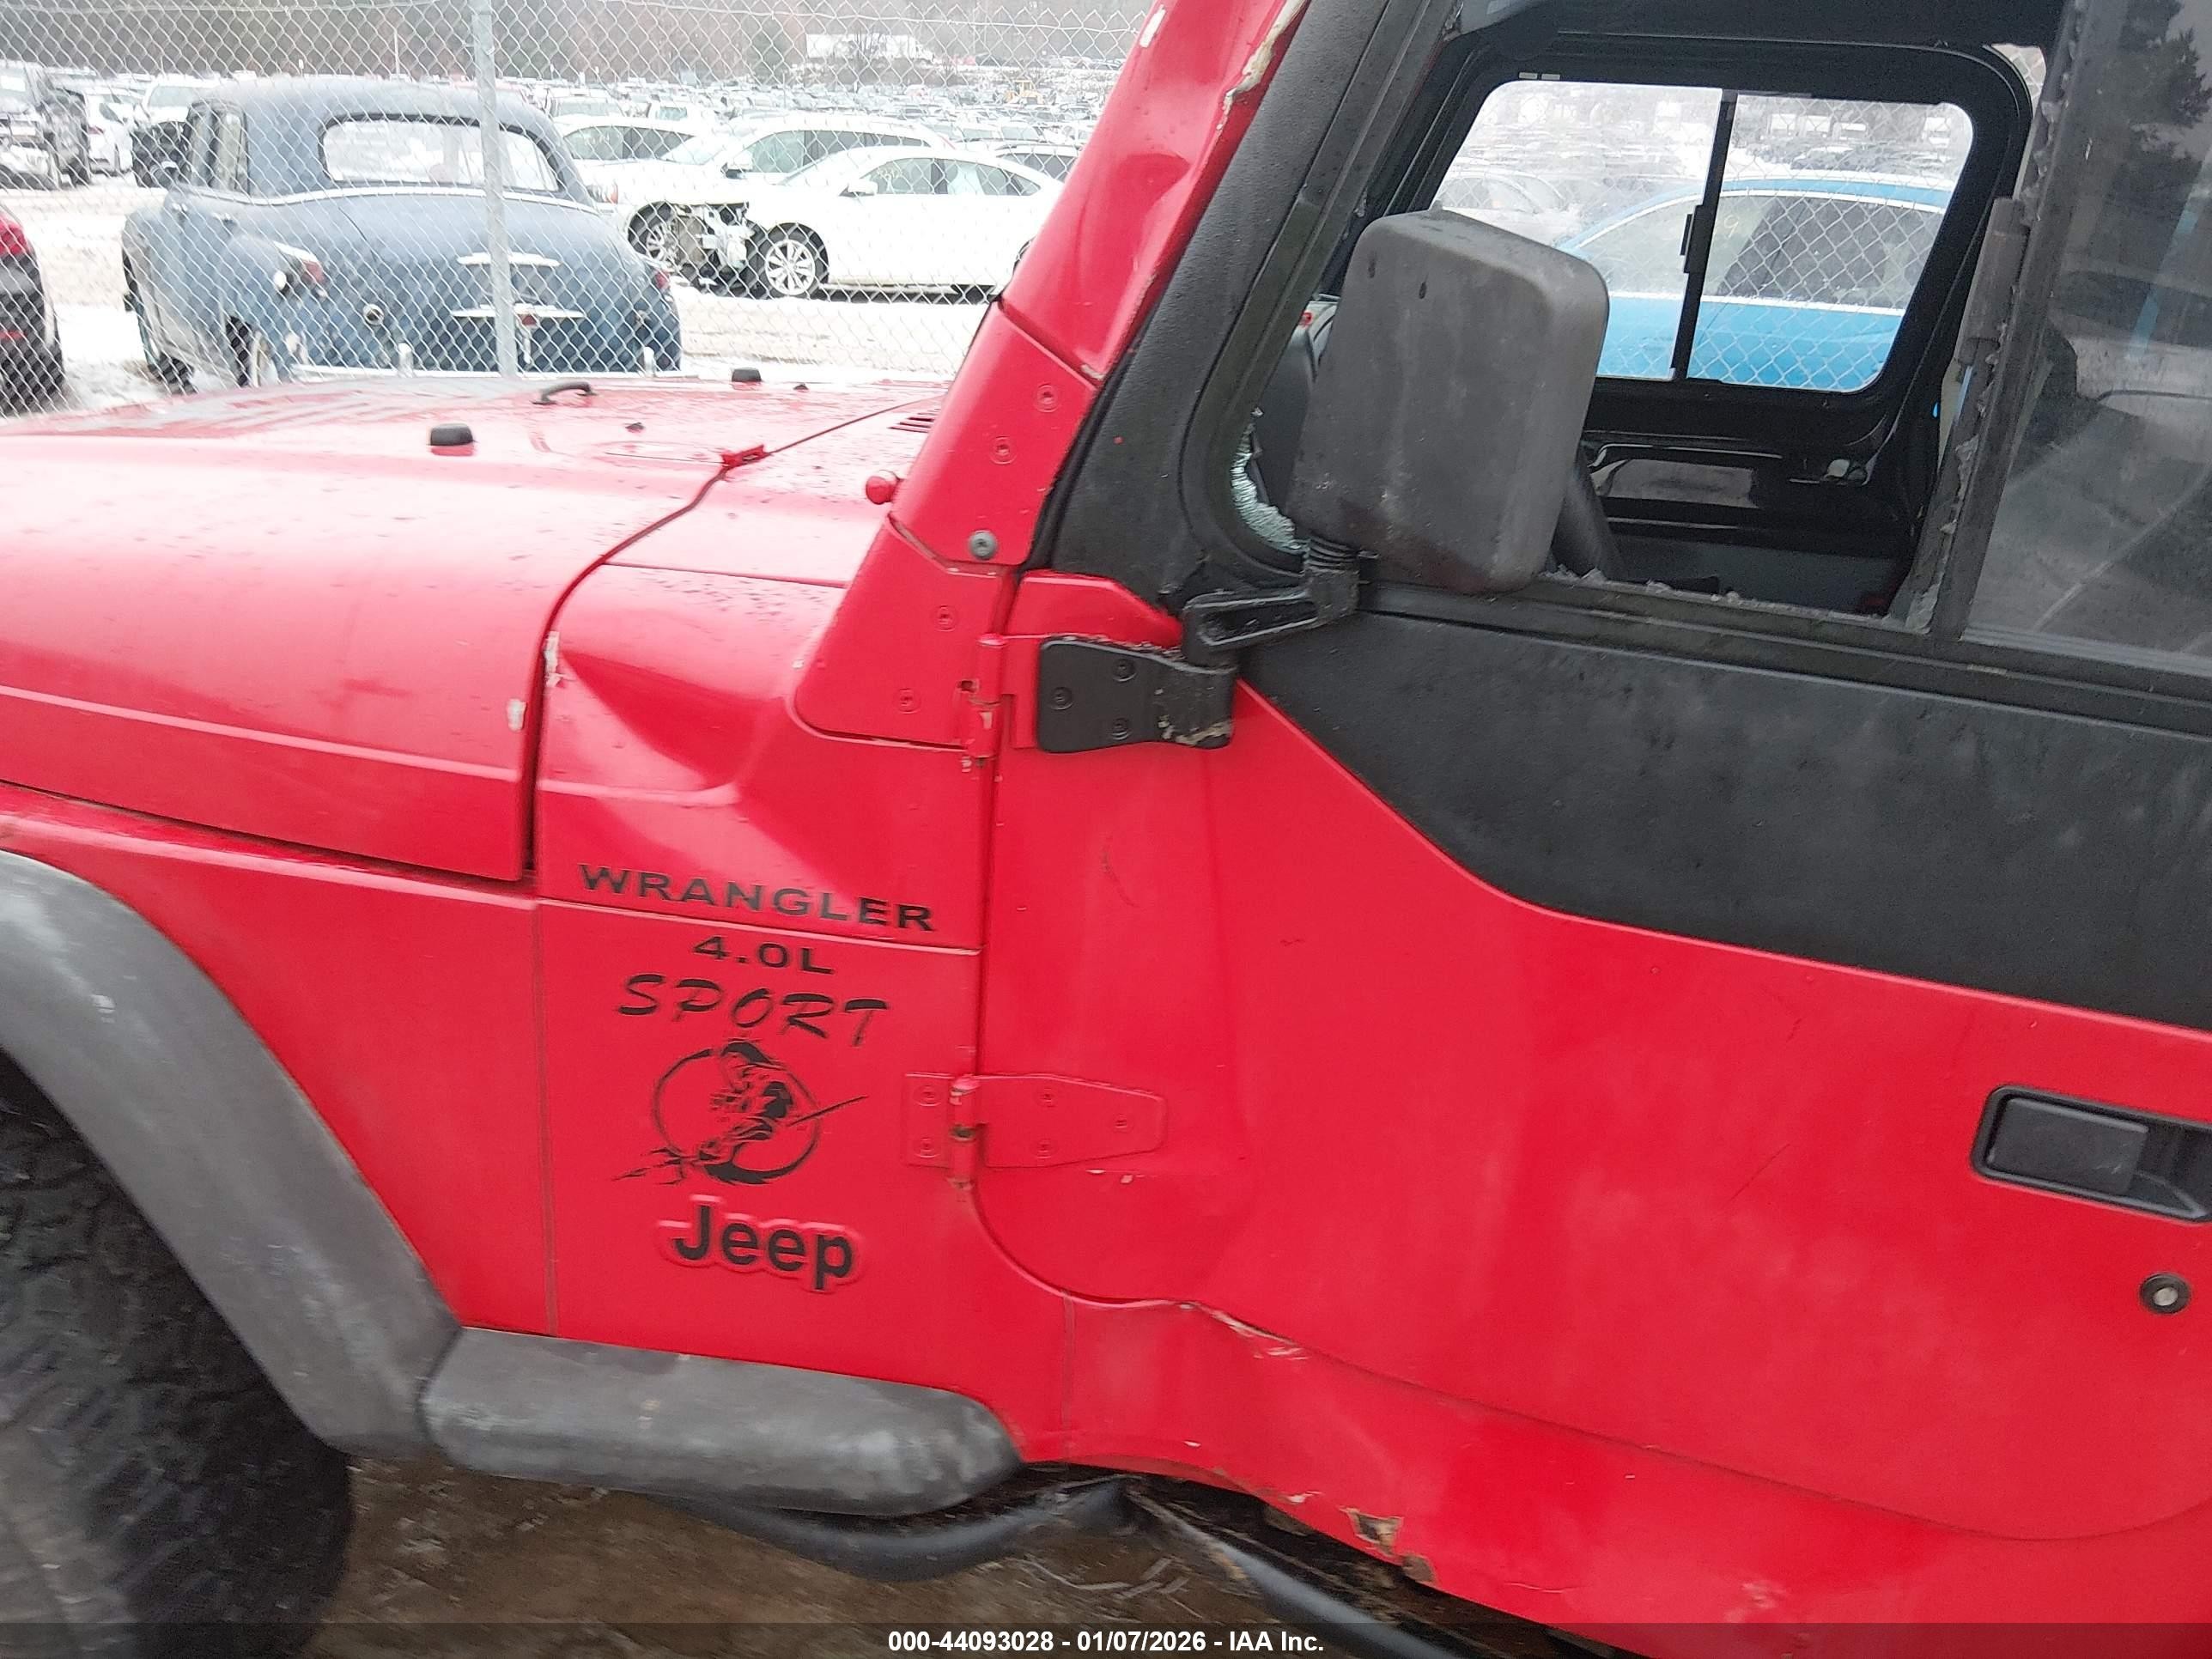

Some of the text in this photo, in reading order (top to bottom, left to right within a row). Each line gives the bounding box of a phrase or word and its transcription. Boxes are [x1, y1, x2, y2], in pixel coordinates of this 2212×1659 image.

[580, 865, 934, 931] WRANGLER
[693, 936, 835, 974] 4.0L
[617, 974, 889, 1046] SPORT
[674, 1204, 853, 1291] Jeep
